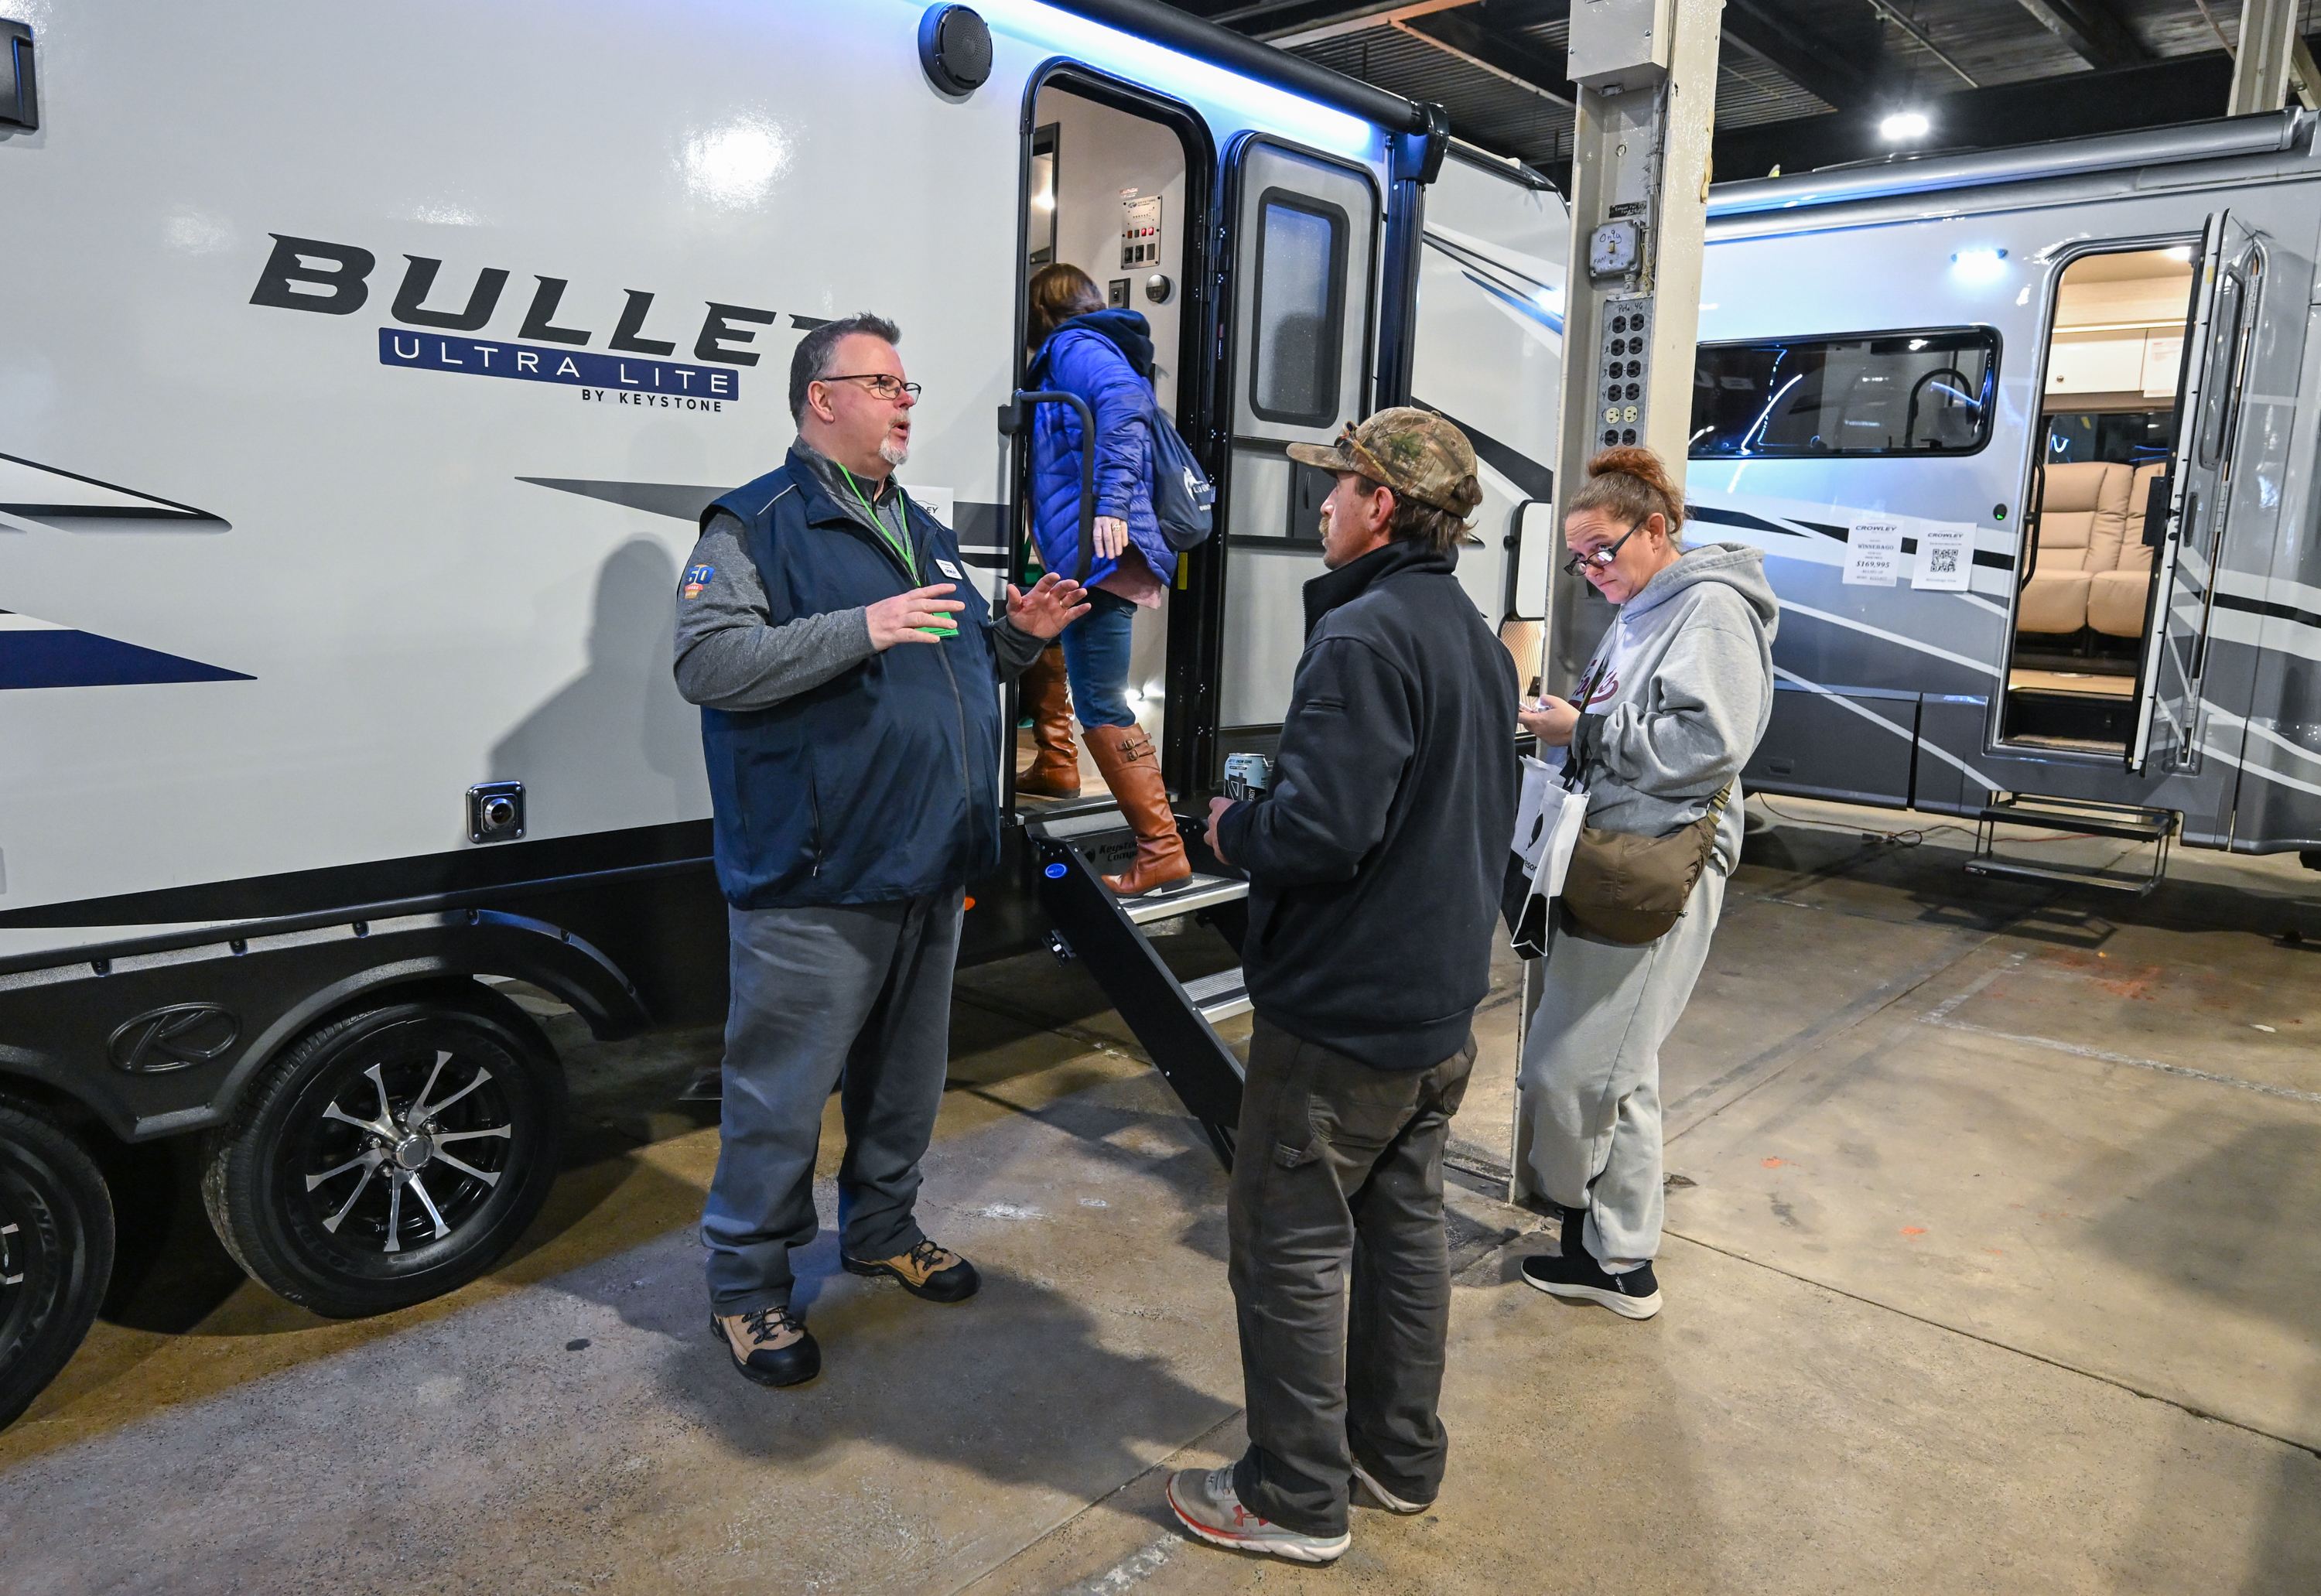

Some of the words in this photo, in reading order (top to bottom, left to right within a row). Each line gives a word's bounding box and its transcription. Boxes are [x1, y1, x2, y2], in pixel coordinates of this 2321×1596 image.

[393, 336, 581, 378] ULTRA
[620, 364, 730, 395] LITE
[582, 388, 604, 402] BY
[619, 392, 723, 412] KEYSTONE
